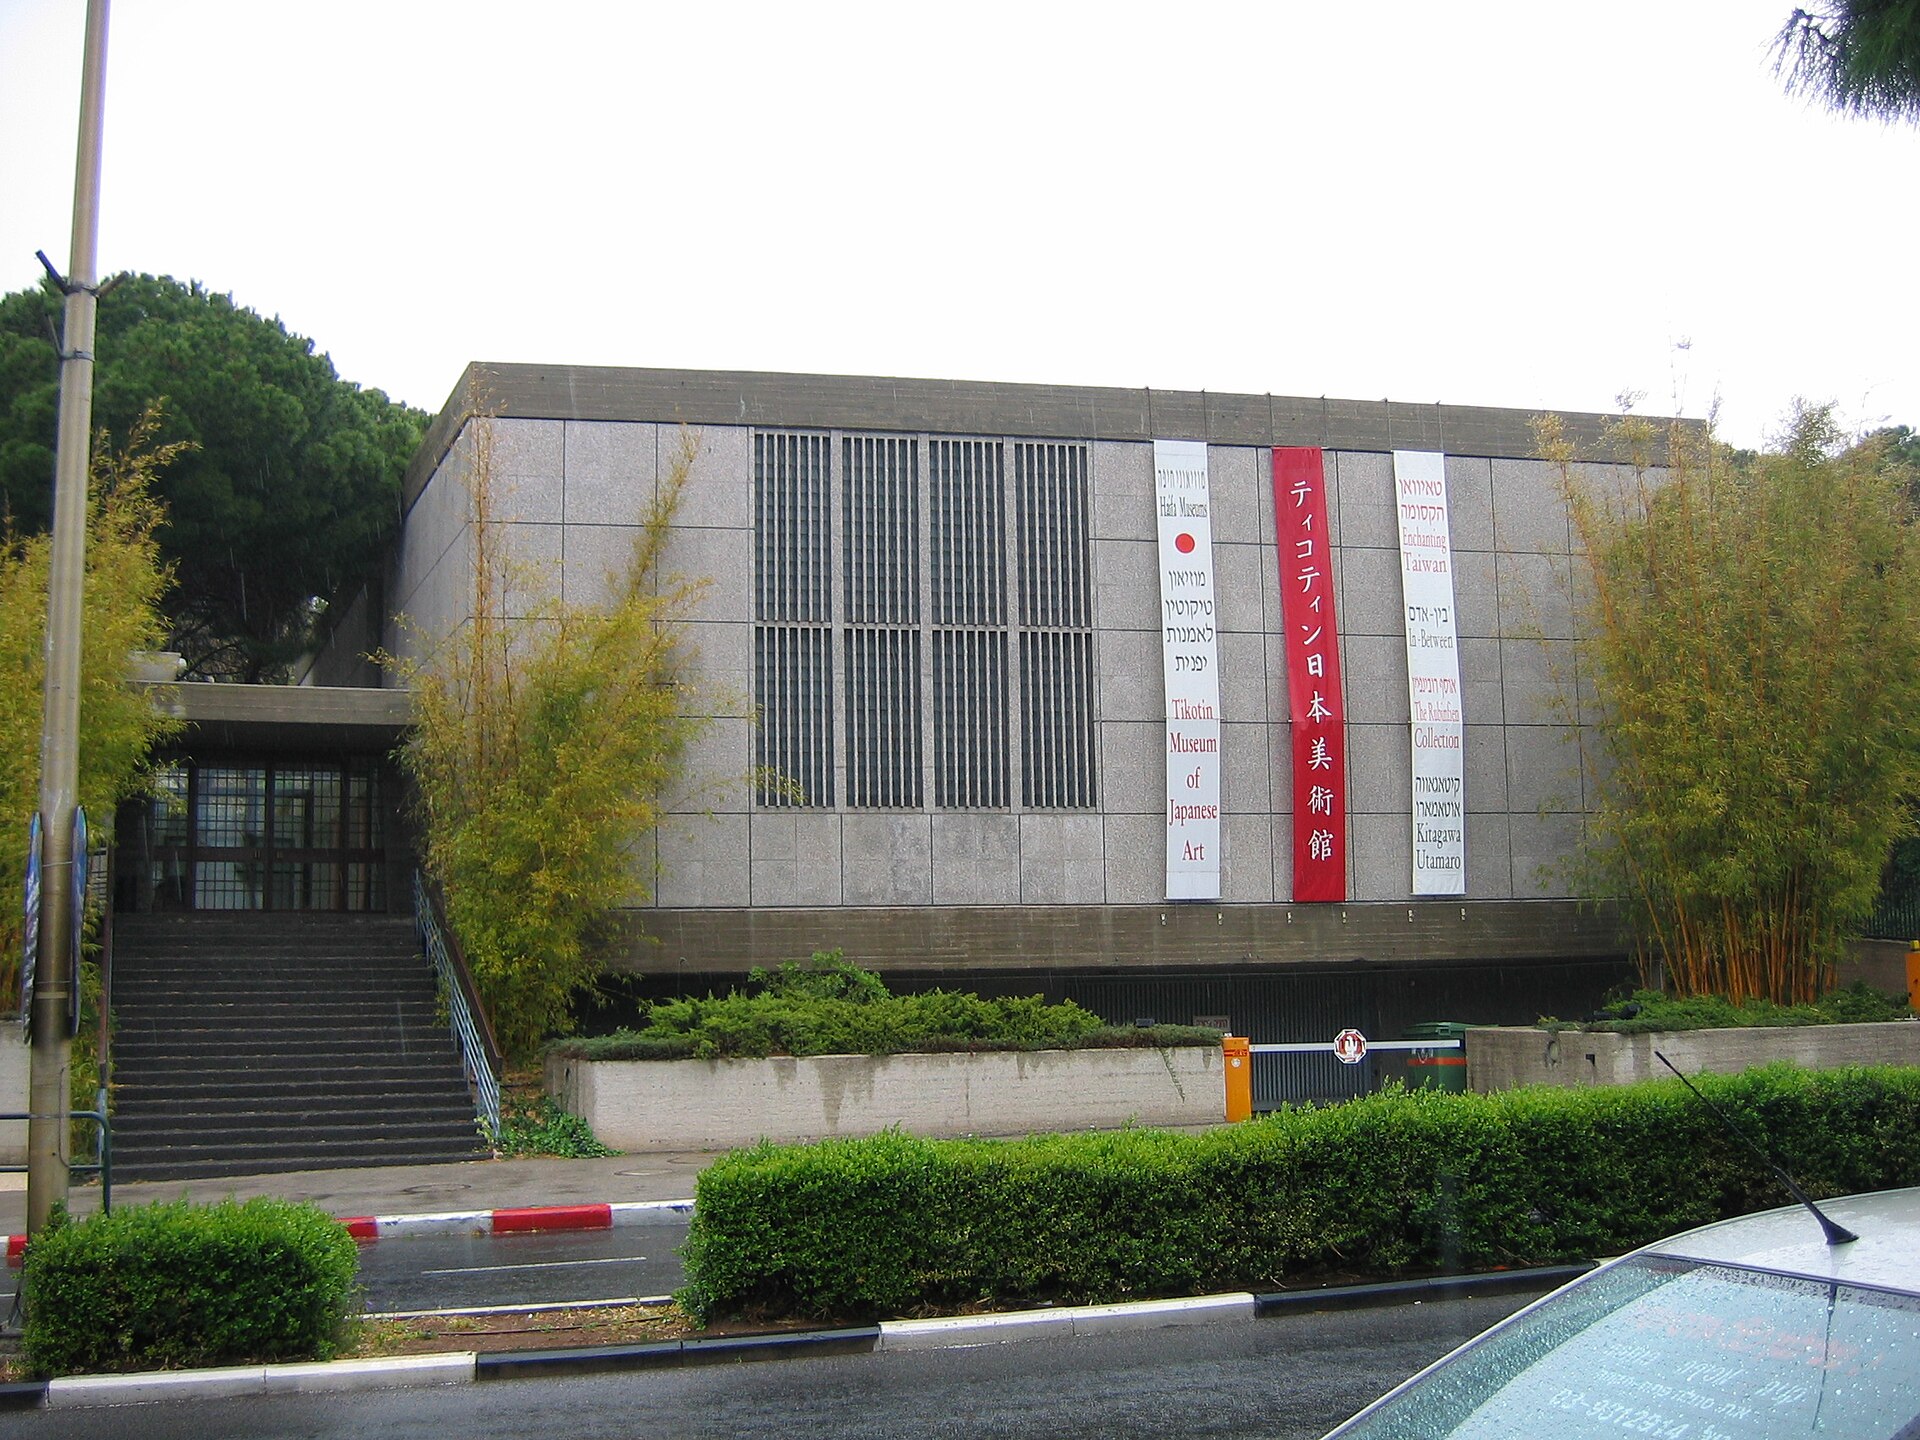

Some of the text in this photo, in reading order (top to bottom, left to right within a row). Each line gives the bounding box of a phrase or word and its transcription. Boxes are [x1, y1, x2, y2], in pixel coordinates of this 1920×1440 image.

[1399, 478, 1442, 499] טאיוואן
[1160, 494, 1208, 518] Haifa Museums
[1400, 503, 1444, 526] הקסומה
[1403, 527, 1447, 554] Enchanting
[1404, 552, 1448, 572] Taiwan
[1168, 571, 1206, 591] מוזיאון
[1166, 599, 1213, 620] טיקוטין
[1166, 623, 1214, 644] לאמנות
[1175, 655, 1208, 672] יפנית
[1172, 699, 1214, 720] Tikotin
[1414, 701, 1427, 721] The
[1170, 732, 1217, 753] Museum
[1414, 727, 1460, 748] Collection
[1186, 766, 1201, 788] of
[1169, 799, 1218, 826] Japanese
[1417, 822, 1462, 849] Kitagawa
[1182, 840, 1205, 861] Art
[1416, 850, 1461, 869] Utamaro
